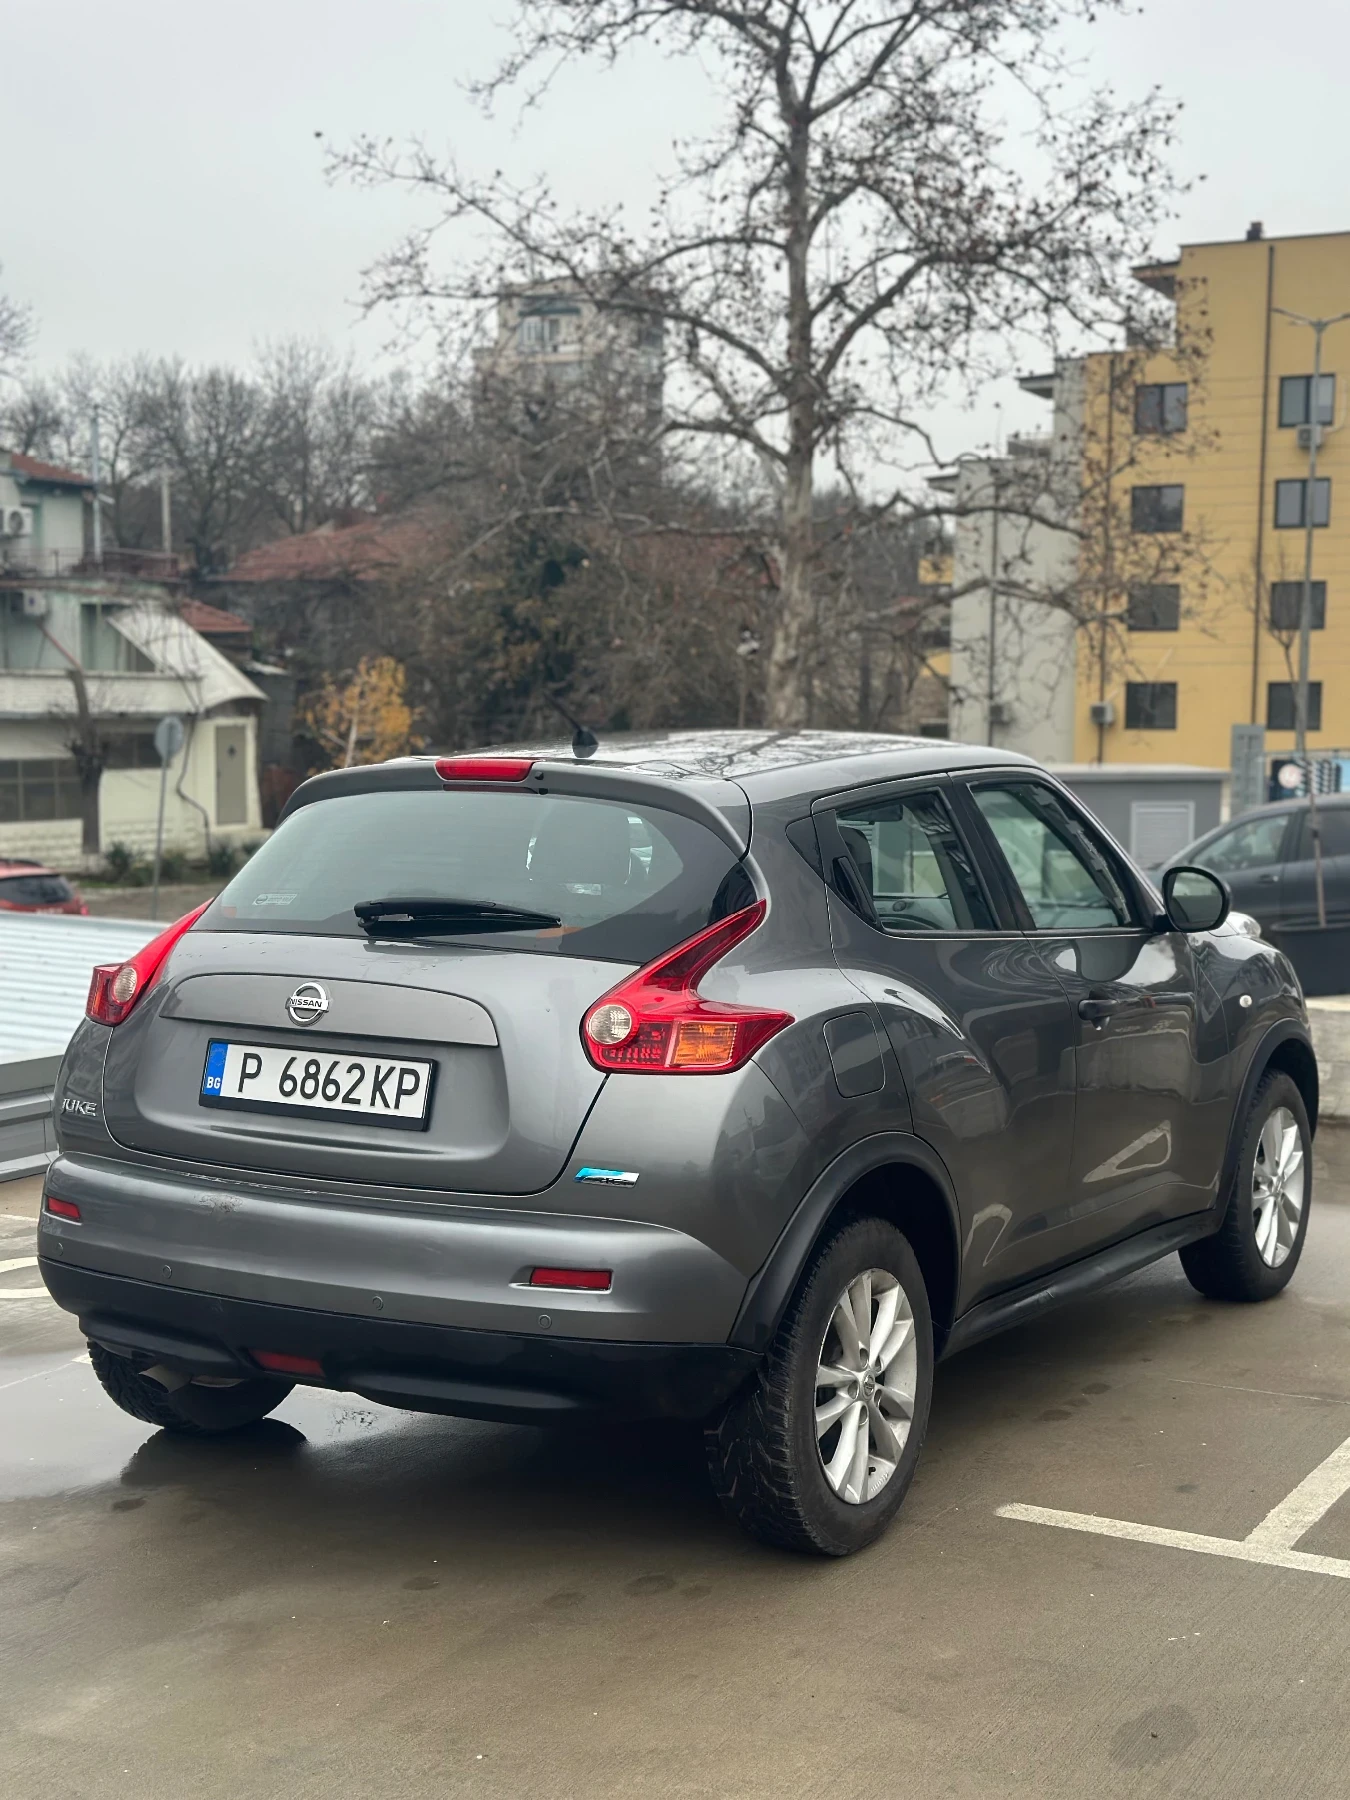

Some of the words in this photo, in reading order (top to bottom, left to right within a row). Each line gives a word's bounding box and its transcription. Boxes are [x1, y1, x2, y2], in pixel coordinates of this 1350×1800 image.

[290, 998, 323, 1008] NISSAN
[237, 1052, 263, 1093] P
[206, 1076, 221, 1089] BG
[61, 1098, 97, 1117] JUKE
